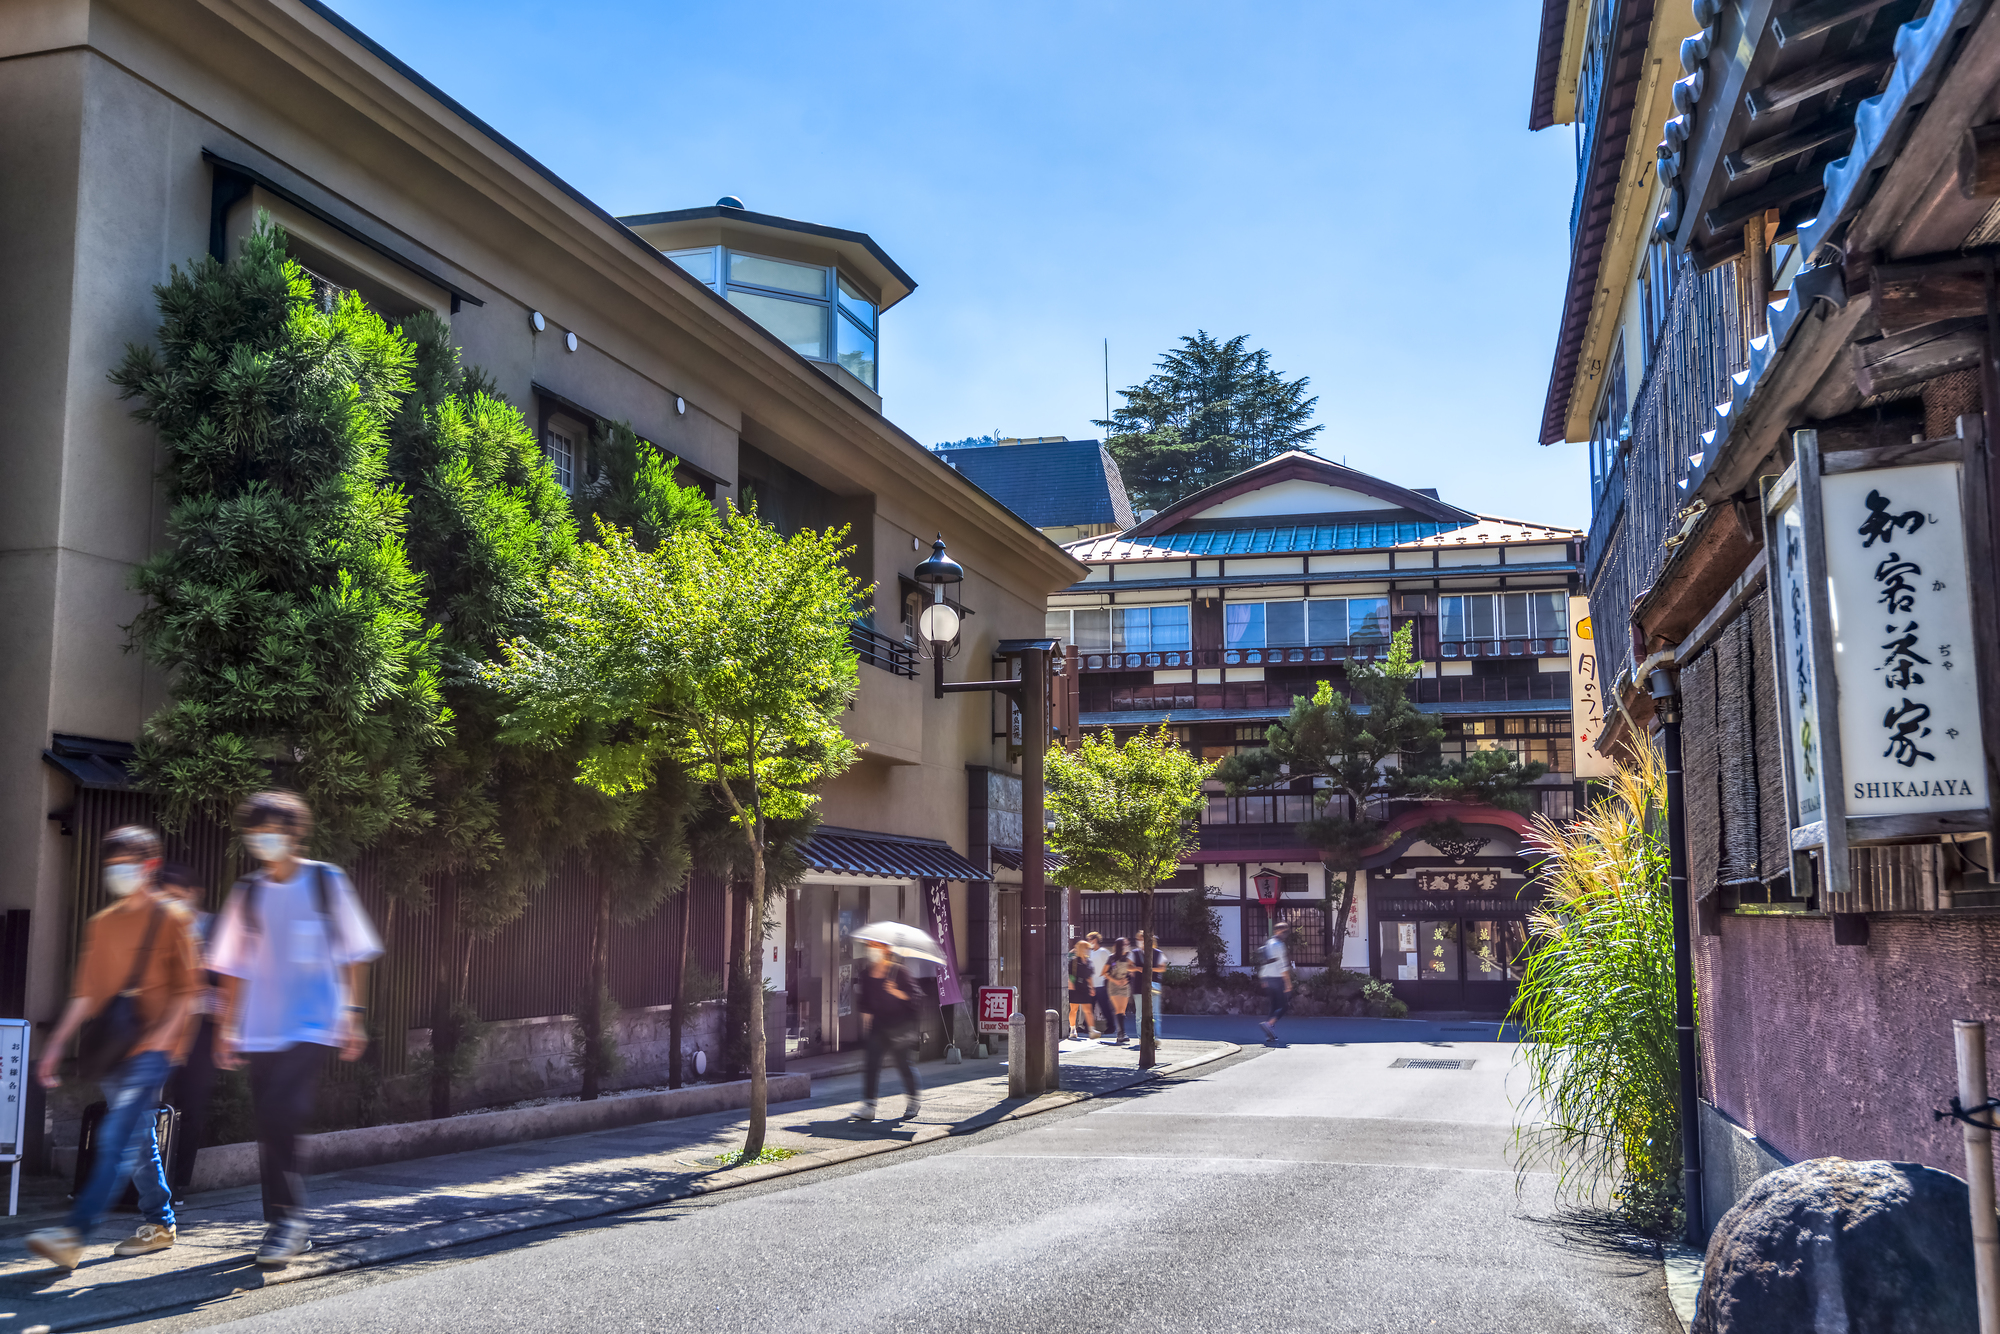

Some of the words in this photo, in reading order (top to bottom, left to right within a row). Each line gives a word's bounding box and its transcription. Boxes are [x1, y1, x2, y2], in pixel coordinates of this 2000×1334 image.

[1858, 489, 1935, 767] 知客茶家
[1854, 779, 1972, 799] SHIKAJAYA
[1432, 927, 1446, 972] 萬寿福
[1478, 927, 1492, 973] 萬寿福
[980, 1021, 997, 1031] Liquor
[984, 992, 1008, 1018] 酒
[7, 1043, 20, 1103] お客様各位
